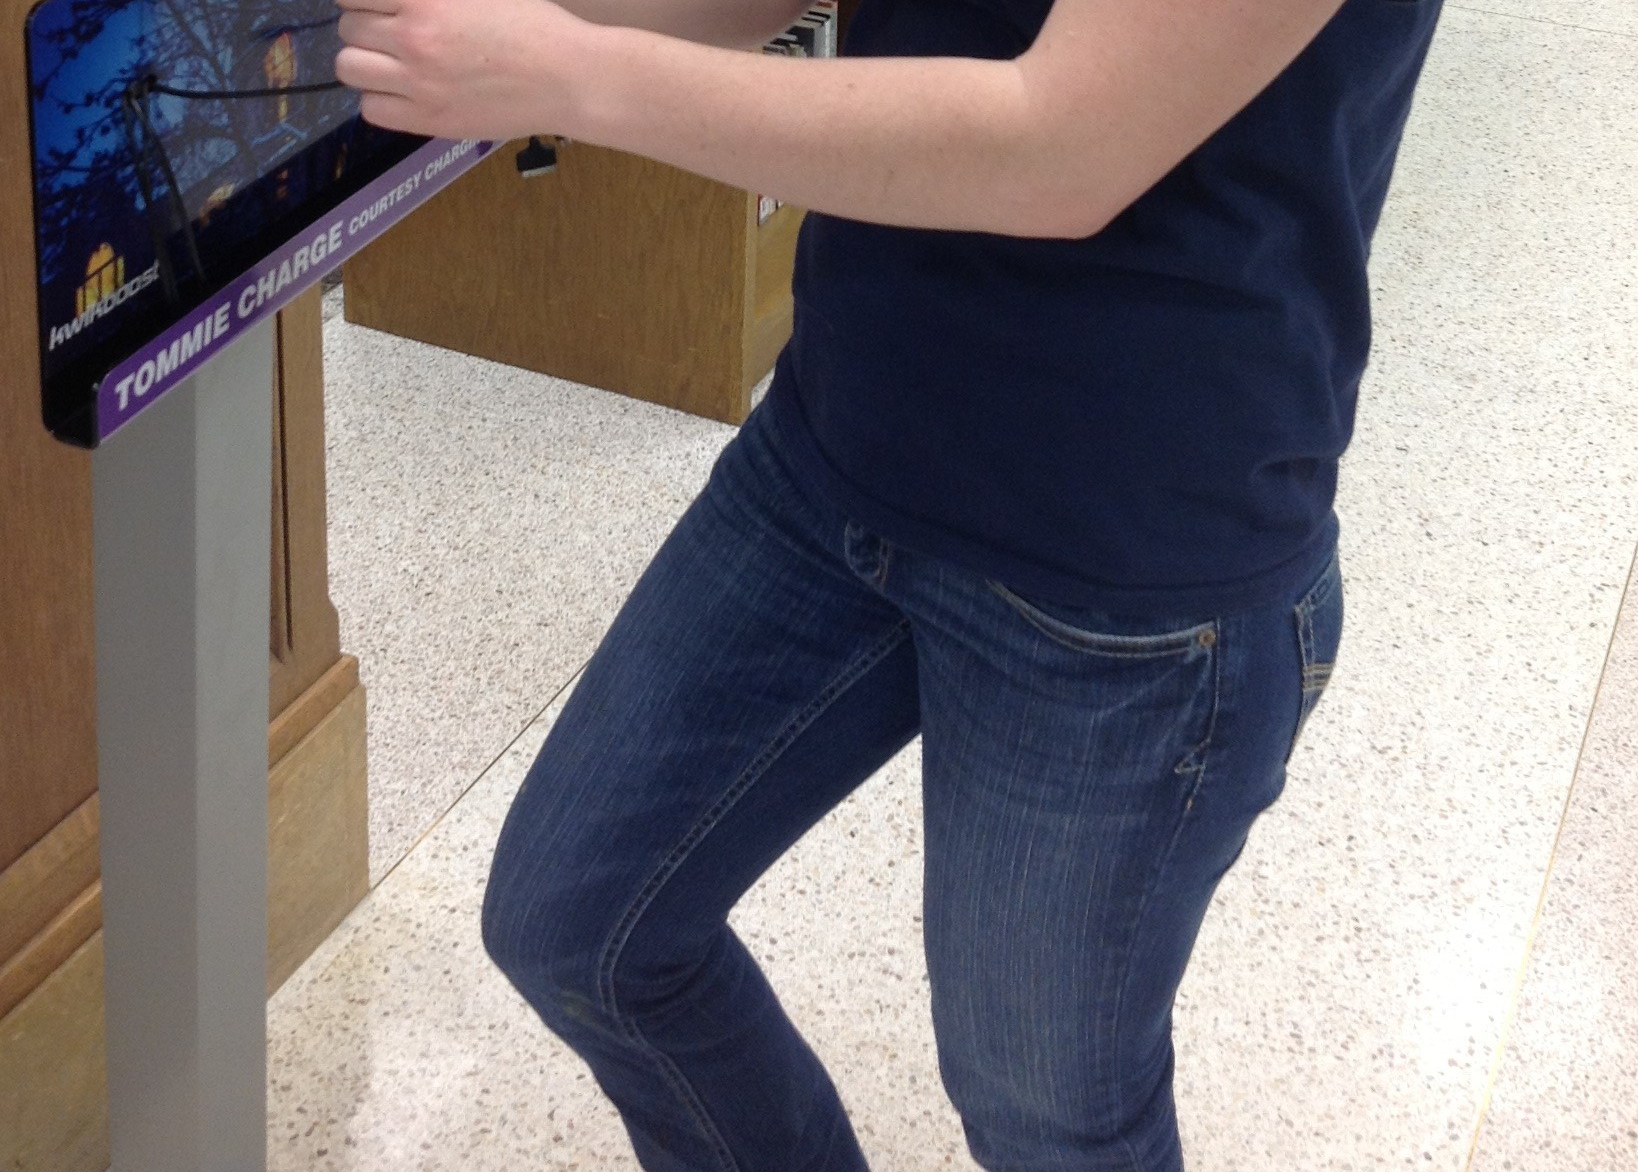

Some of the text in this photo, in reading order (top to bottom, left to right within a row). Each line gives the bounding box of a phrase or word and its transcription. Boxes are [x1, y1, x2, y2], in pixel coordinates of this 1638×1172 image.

[114, 301, 231, 412] TOMMIE
[236, 219, 344, 319] CHARGE
[348, 170, 423, 236] COURTESY
